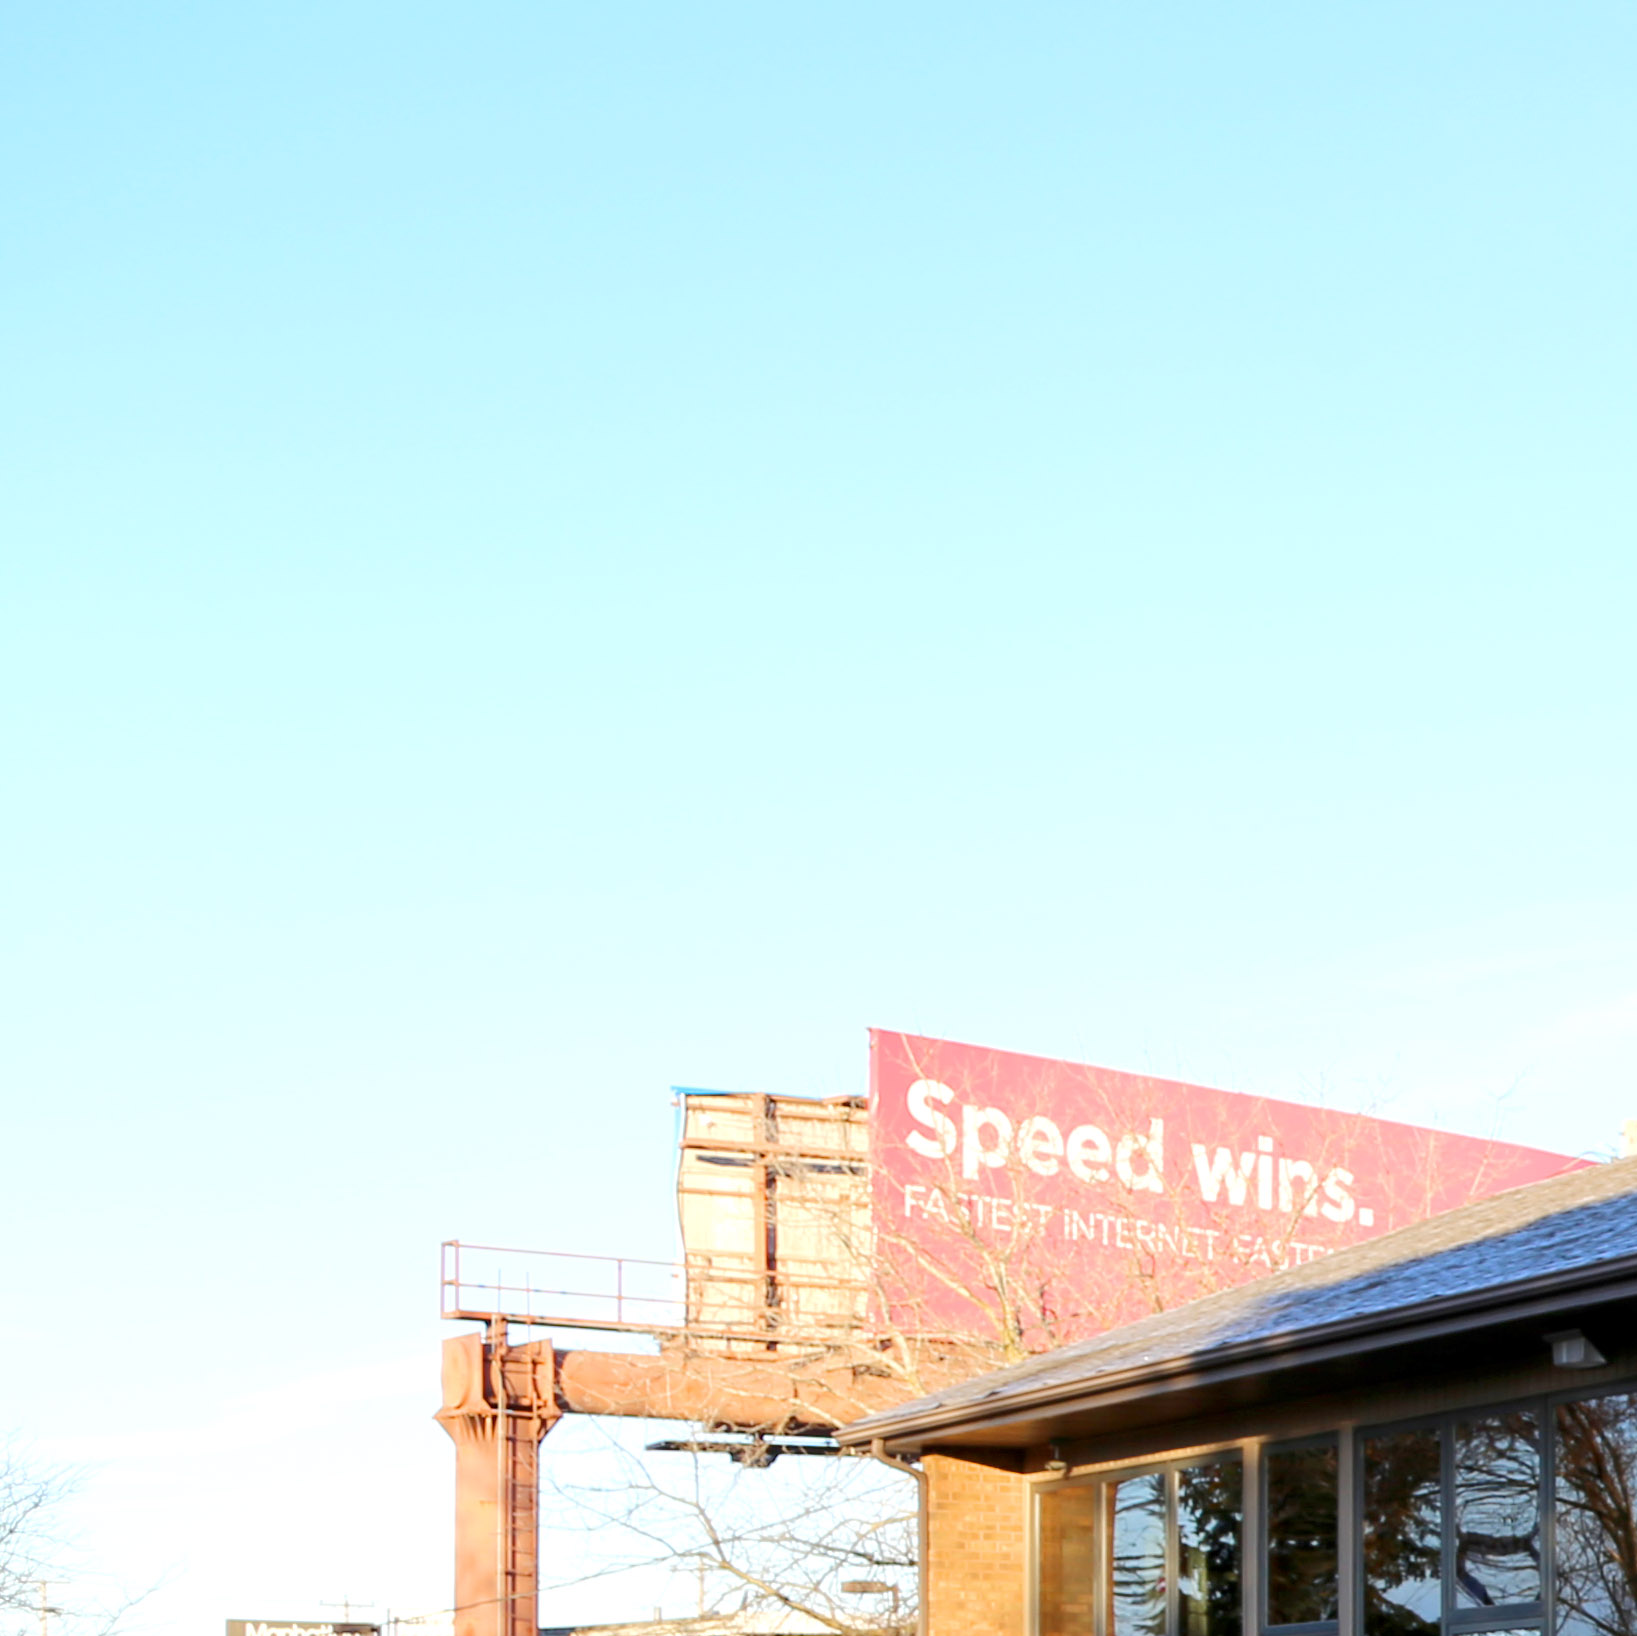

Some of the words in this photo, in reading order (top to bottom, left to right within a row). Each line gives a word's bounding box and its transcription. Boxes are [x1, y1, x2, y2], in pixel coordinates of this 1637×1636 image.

[905, 1079, 1164, 1194] Speed
[1192, 1136, 1375, 1227] wins.
[904, 1184, 1052, 1235] FASTEST
[1064, 1208, 1219, 1259] INTERNET
